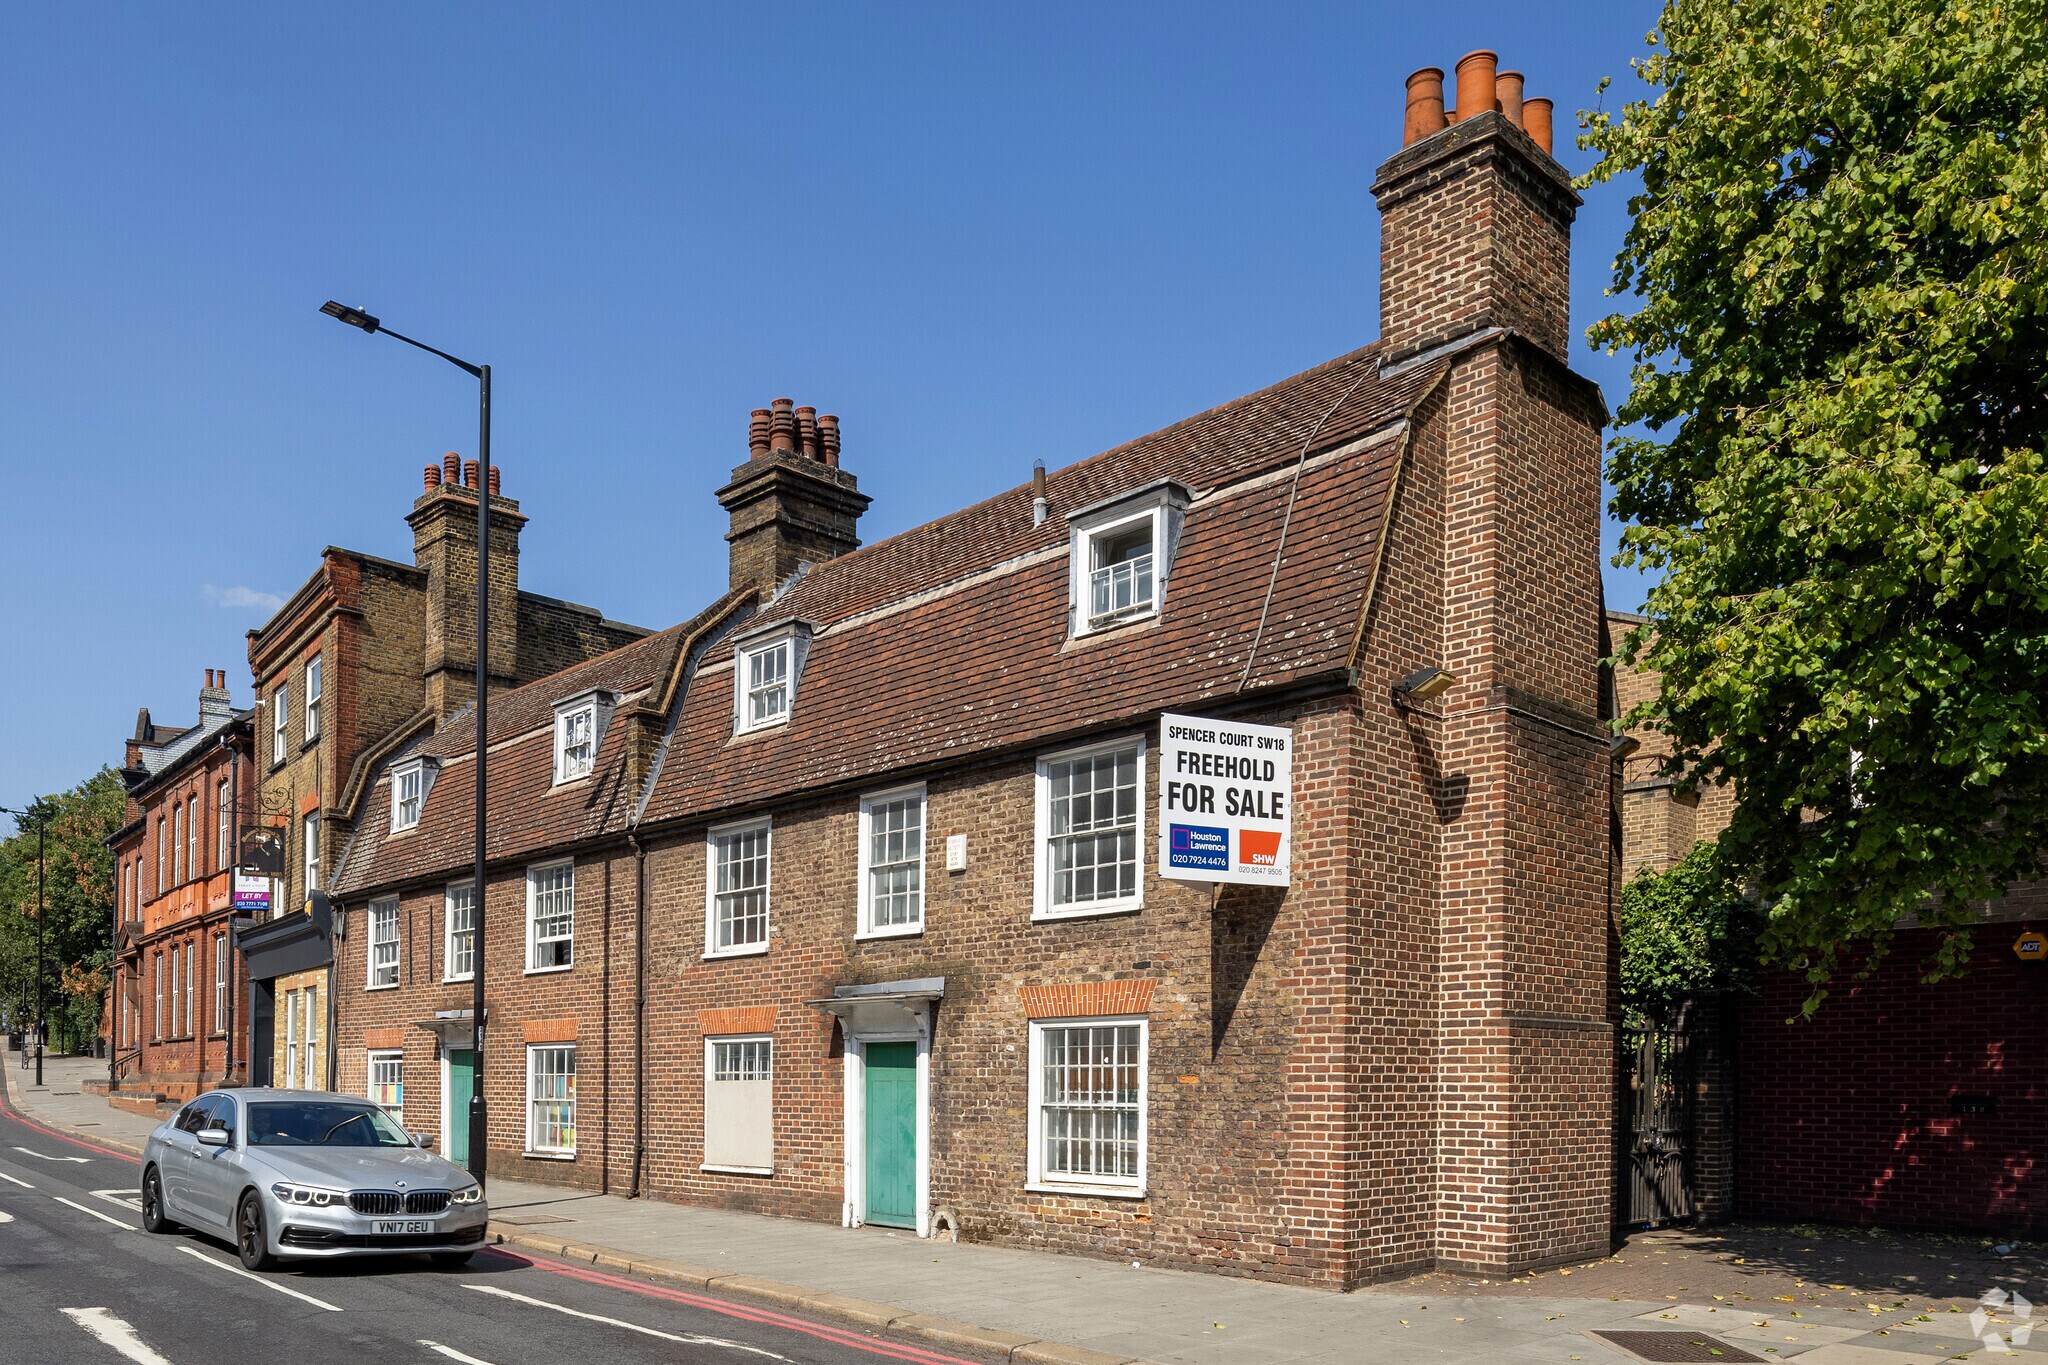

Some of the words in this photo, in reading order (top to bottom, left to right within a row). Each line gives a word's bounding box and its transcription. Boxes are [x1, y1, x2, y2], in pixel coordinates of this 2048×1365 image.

[1169, 725, 1216, 744] SPENCER
[1219, 731, 1254, 748] COURT
[1257, 736, 1285, 751] SW18
[1177, 750, 1275, 782] FREEHOLD
[1168, 781, 1215, 814] FOR
[1225, 787, 1284, 820] SALE
[1190, 831, 1221, 842] Houston
[1190, 841, 1226, 851] Lawrence
[1172, 854, 1188, 863] 020
[1189, 855, 1207, 865] 7924
[1208, 857, 1226, 866] 4476
[1252, 853, 1275, 864] SHW
[2021, 942, 2040, 951] ADT
[379, 1222, 404, 1233] VN17
[407, 1222, 428, 1233] GEU
